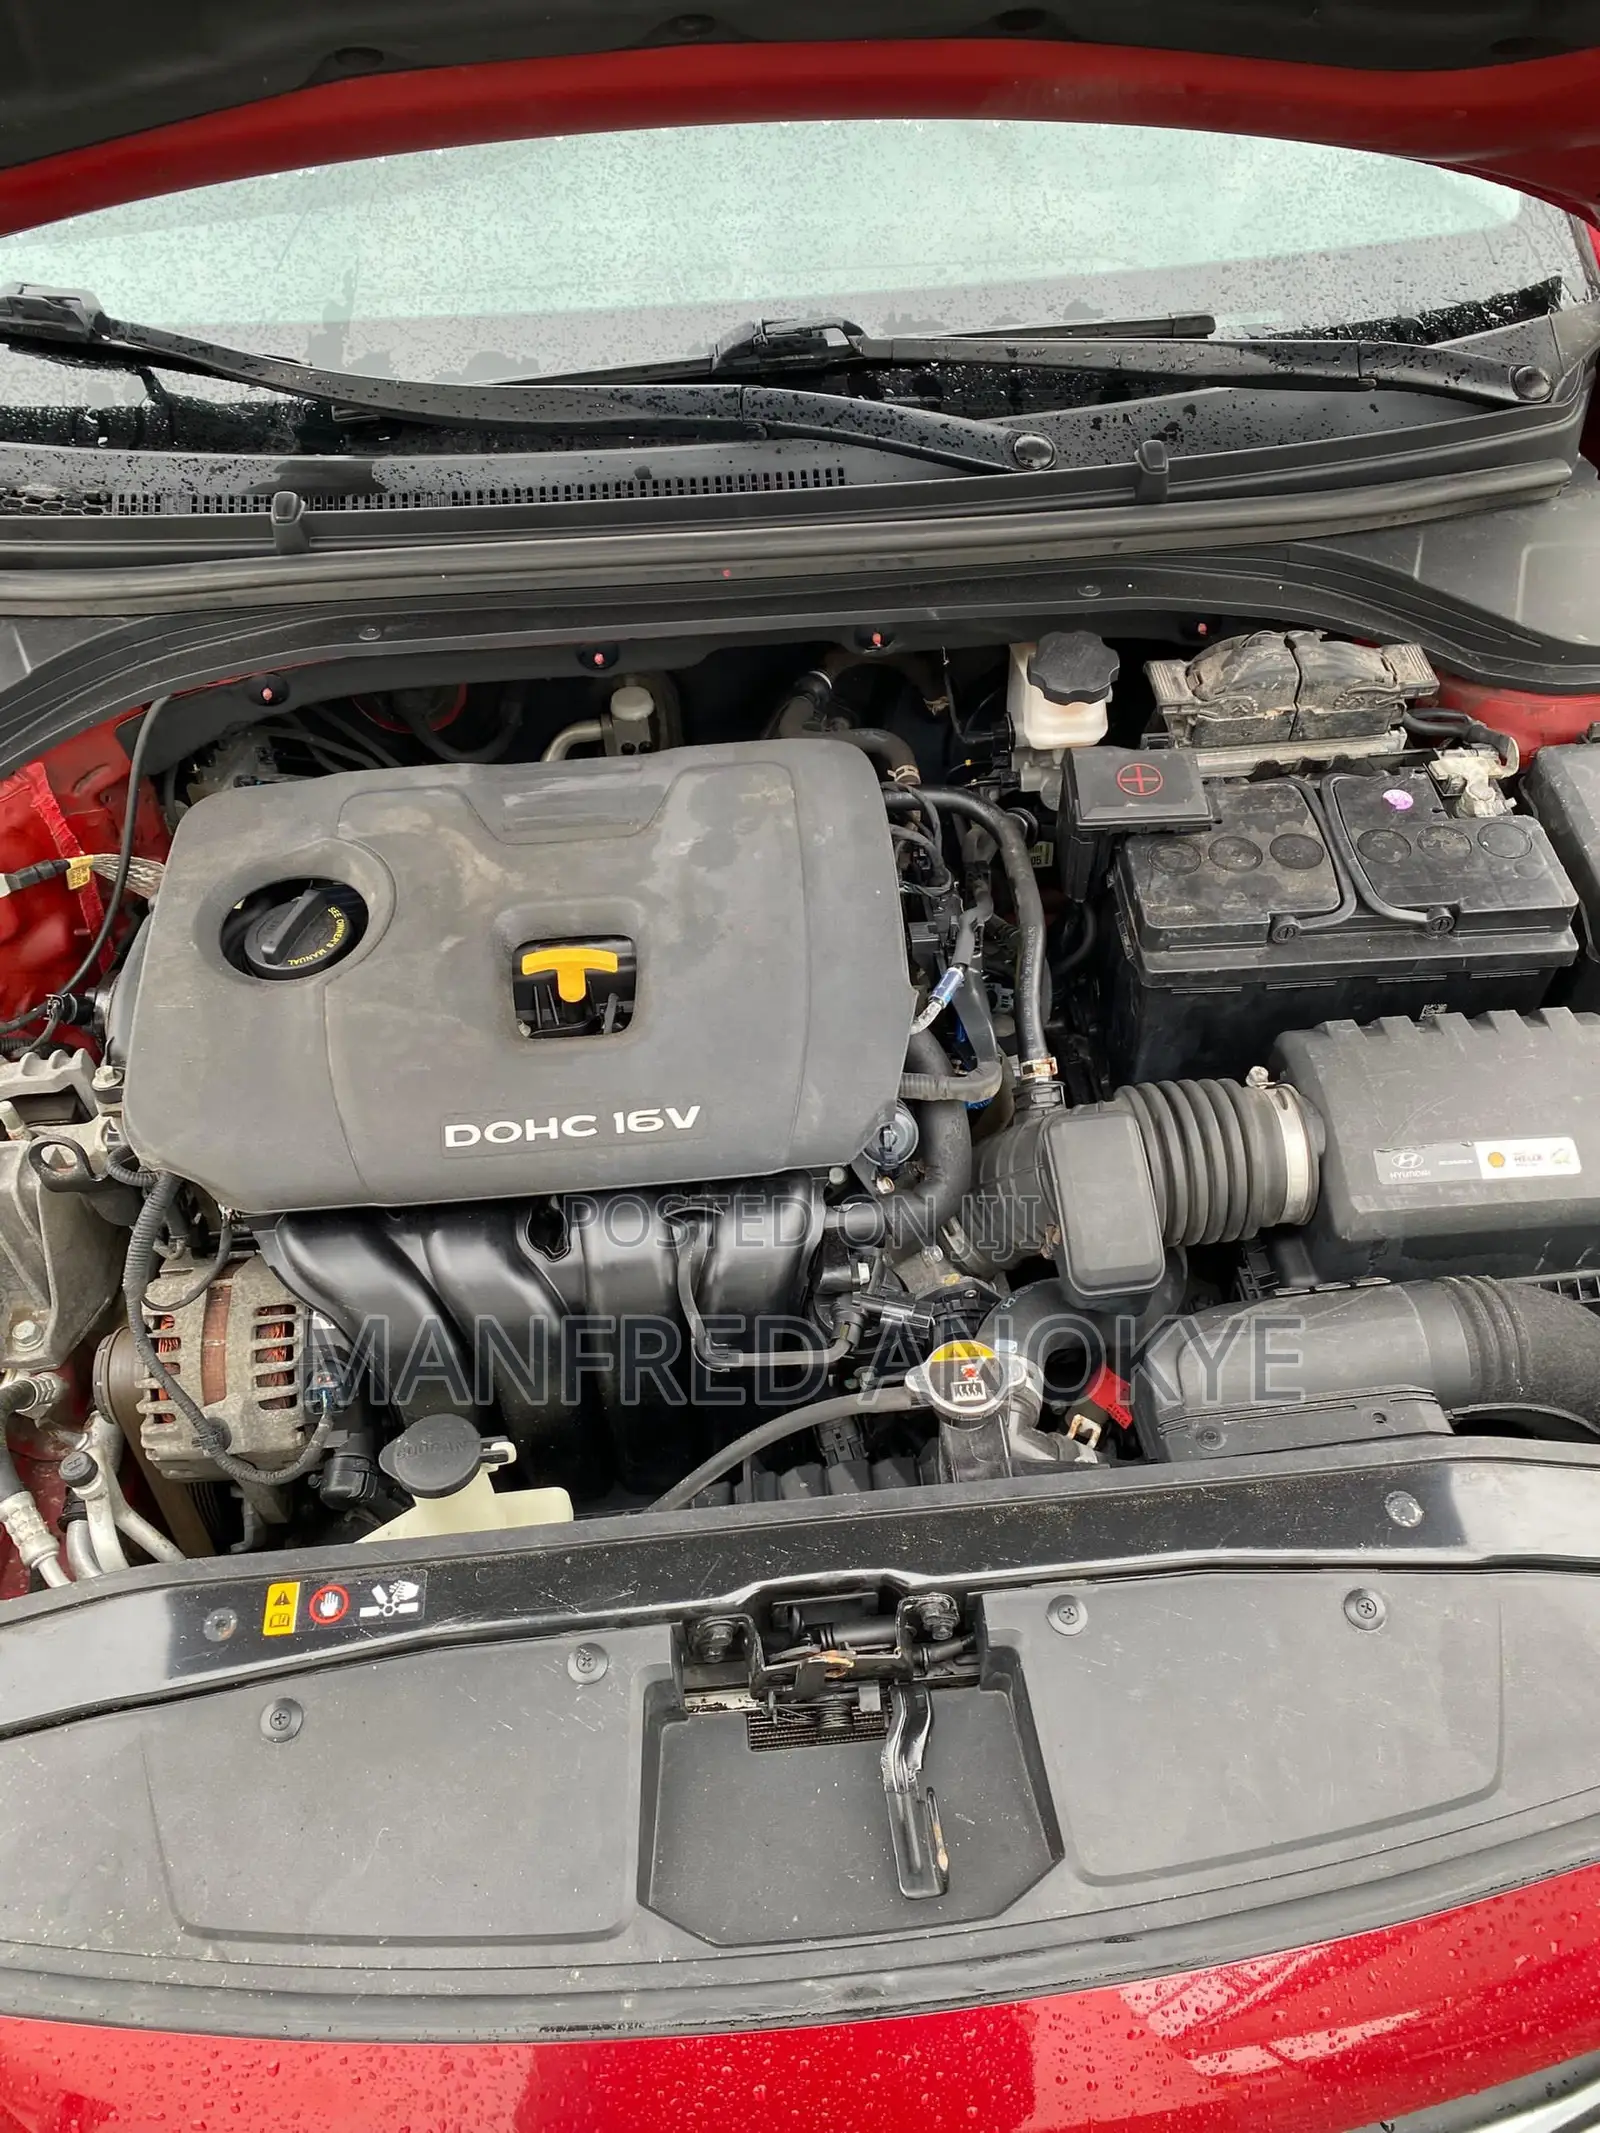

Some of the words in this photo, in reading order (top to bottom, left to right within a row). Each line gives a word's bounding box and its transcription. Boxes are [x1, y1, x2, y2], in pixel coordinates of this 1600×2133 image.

[328, 906, 342, 919] SEE
[326, 918, 345, 948] OWNER'S
[288, 948, 327, 966] MANUAL
[444, 1114, 598, 1148] DOHC
[613, 1105, 701, 1134] 16V
